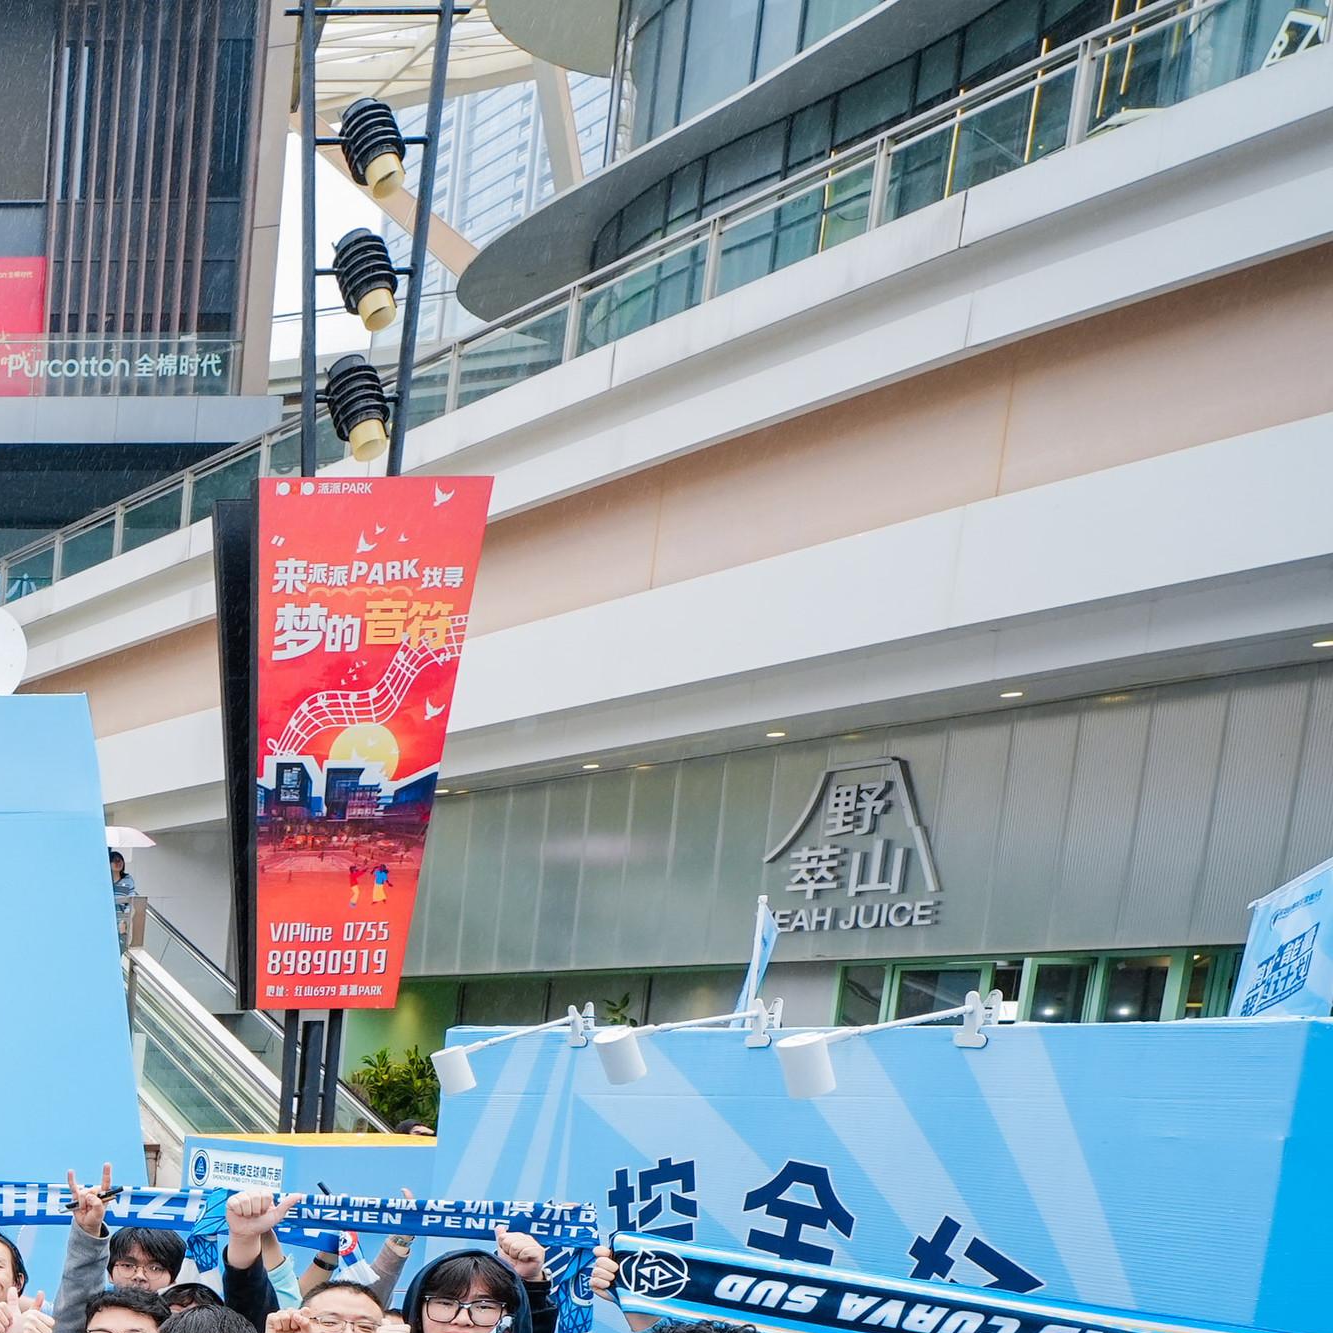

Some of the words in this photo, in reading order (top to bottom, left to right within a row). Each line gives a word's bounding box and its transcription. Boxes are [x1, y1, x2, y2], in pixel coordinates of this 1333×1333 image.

[8, 354, 130, 379] Purcotton
[133, 353, 222, 378] 全棉时代
[824, 780, 891, 837] 野
[785, 839, 907, 900] 萃山
[270, 921, 333, 942] VIPline
[343, 921, 389, 942] 0755
[771, 907, 834, 934] EAH
[838, 901, 939, 932] JUICE
[266, 949, 388, 976] 89890919
[530, 1222, 599, 1241] CITY
[713, 1275, 830, 1314] SUD
